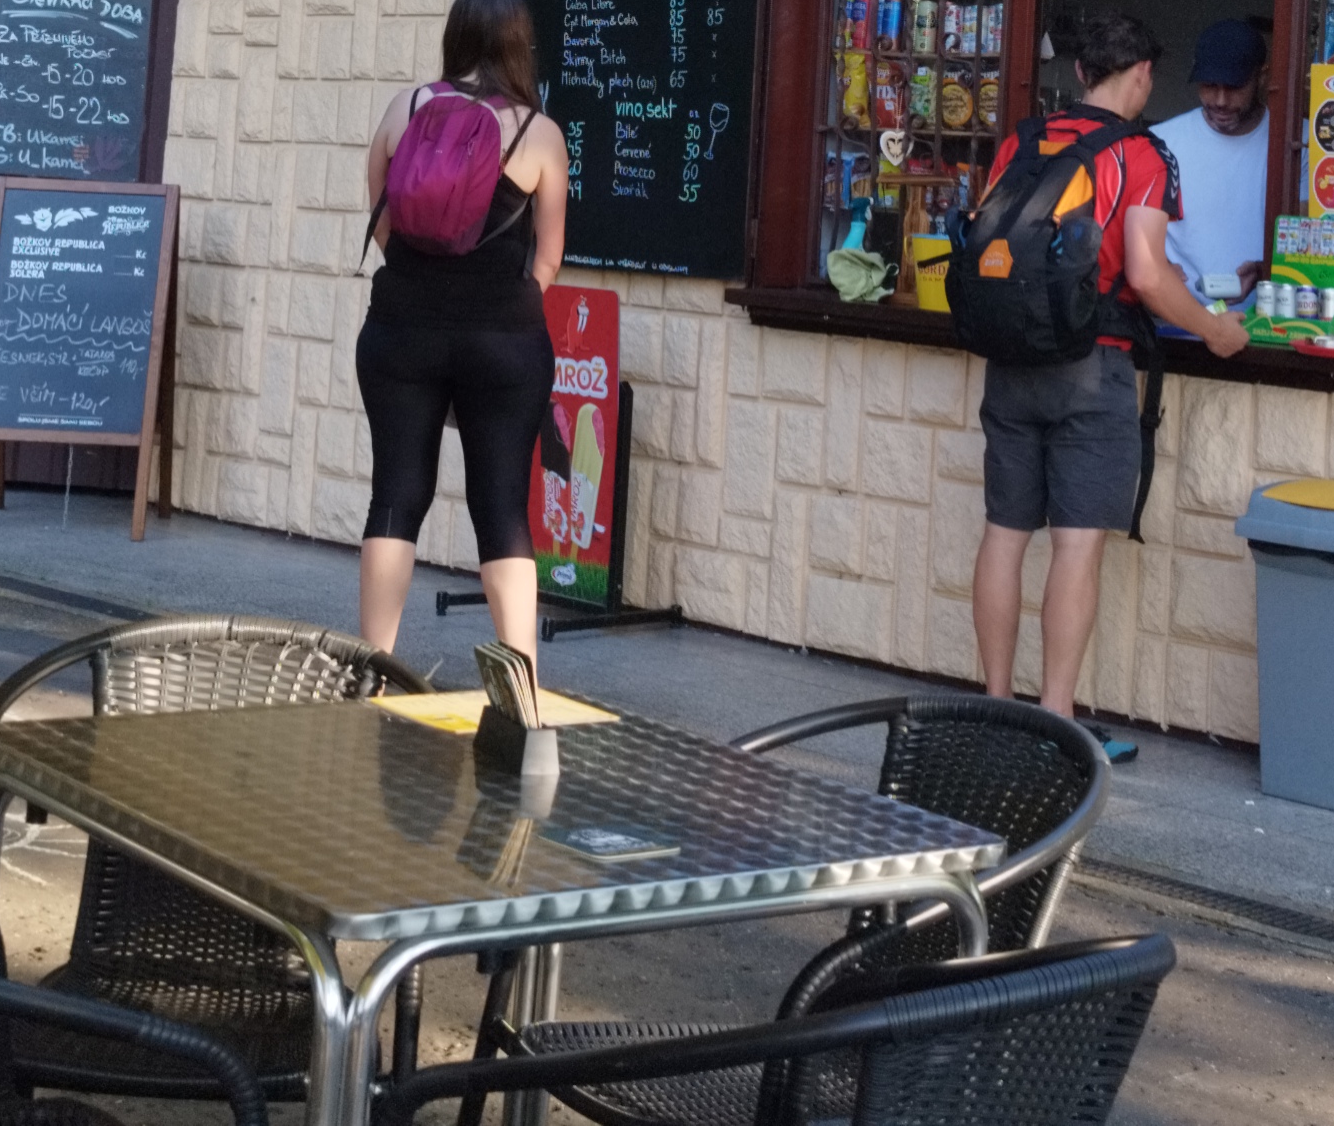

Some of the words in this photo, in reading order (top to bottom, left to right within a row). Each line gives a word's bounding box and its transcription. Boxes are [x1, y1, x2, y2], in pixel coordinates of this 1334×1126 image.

[100, 0, 143, 24] DOBA
[669, 8, 687, 26] 85
[707, 8, 725, 26] 85
[671, 27, 687, 44] 75
[601, 48, 626, 65] Bitch
[671, 46, 688, 63] 75
[609, 72, 634, 94] plech
[669, 69, 688, 89] 65
[568, 121, 585, 137] 35
[685, 124, 701, 140] 50
[683, 143, 699, 159] 50
[614, 160, 655, 179] Prosecco
[683, 161, 698, 180] 60
[678, 184, 701, 202] 55
[108, 205, 146, 215] BOŽKOV
[12, 246, 61, 257] EXCLUSIVE
[13, 236, 51, 248] BOŽKOV
[55, 238, 105, 251] REPUBLICA
[9, 270, 45, 279] SOLERA
[11, 259, 49, 271] BOŽKOV
[52, 262, 103, 273] REPUBLICA
[4, 282, 67, 303] DNES
[17, 303, 89, 332] DOMÁCÍ
[91, 309, 153, 335] LANGOŠ
